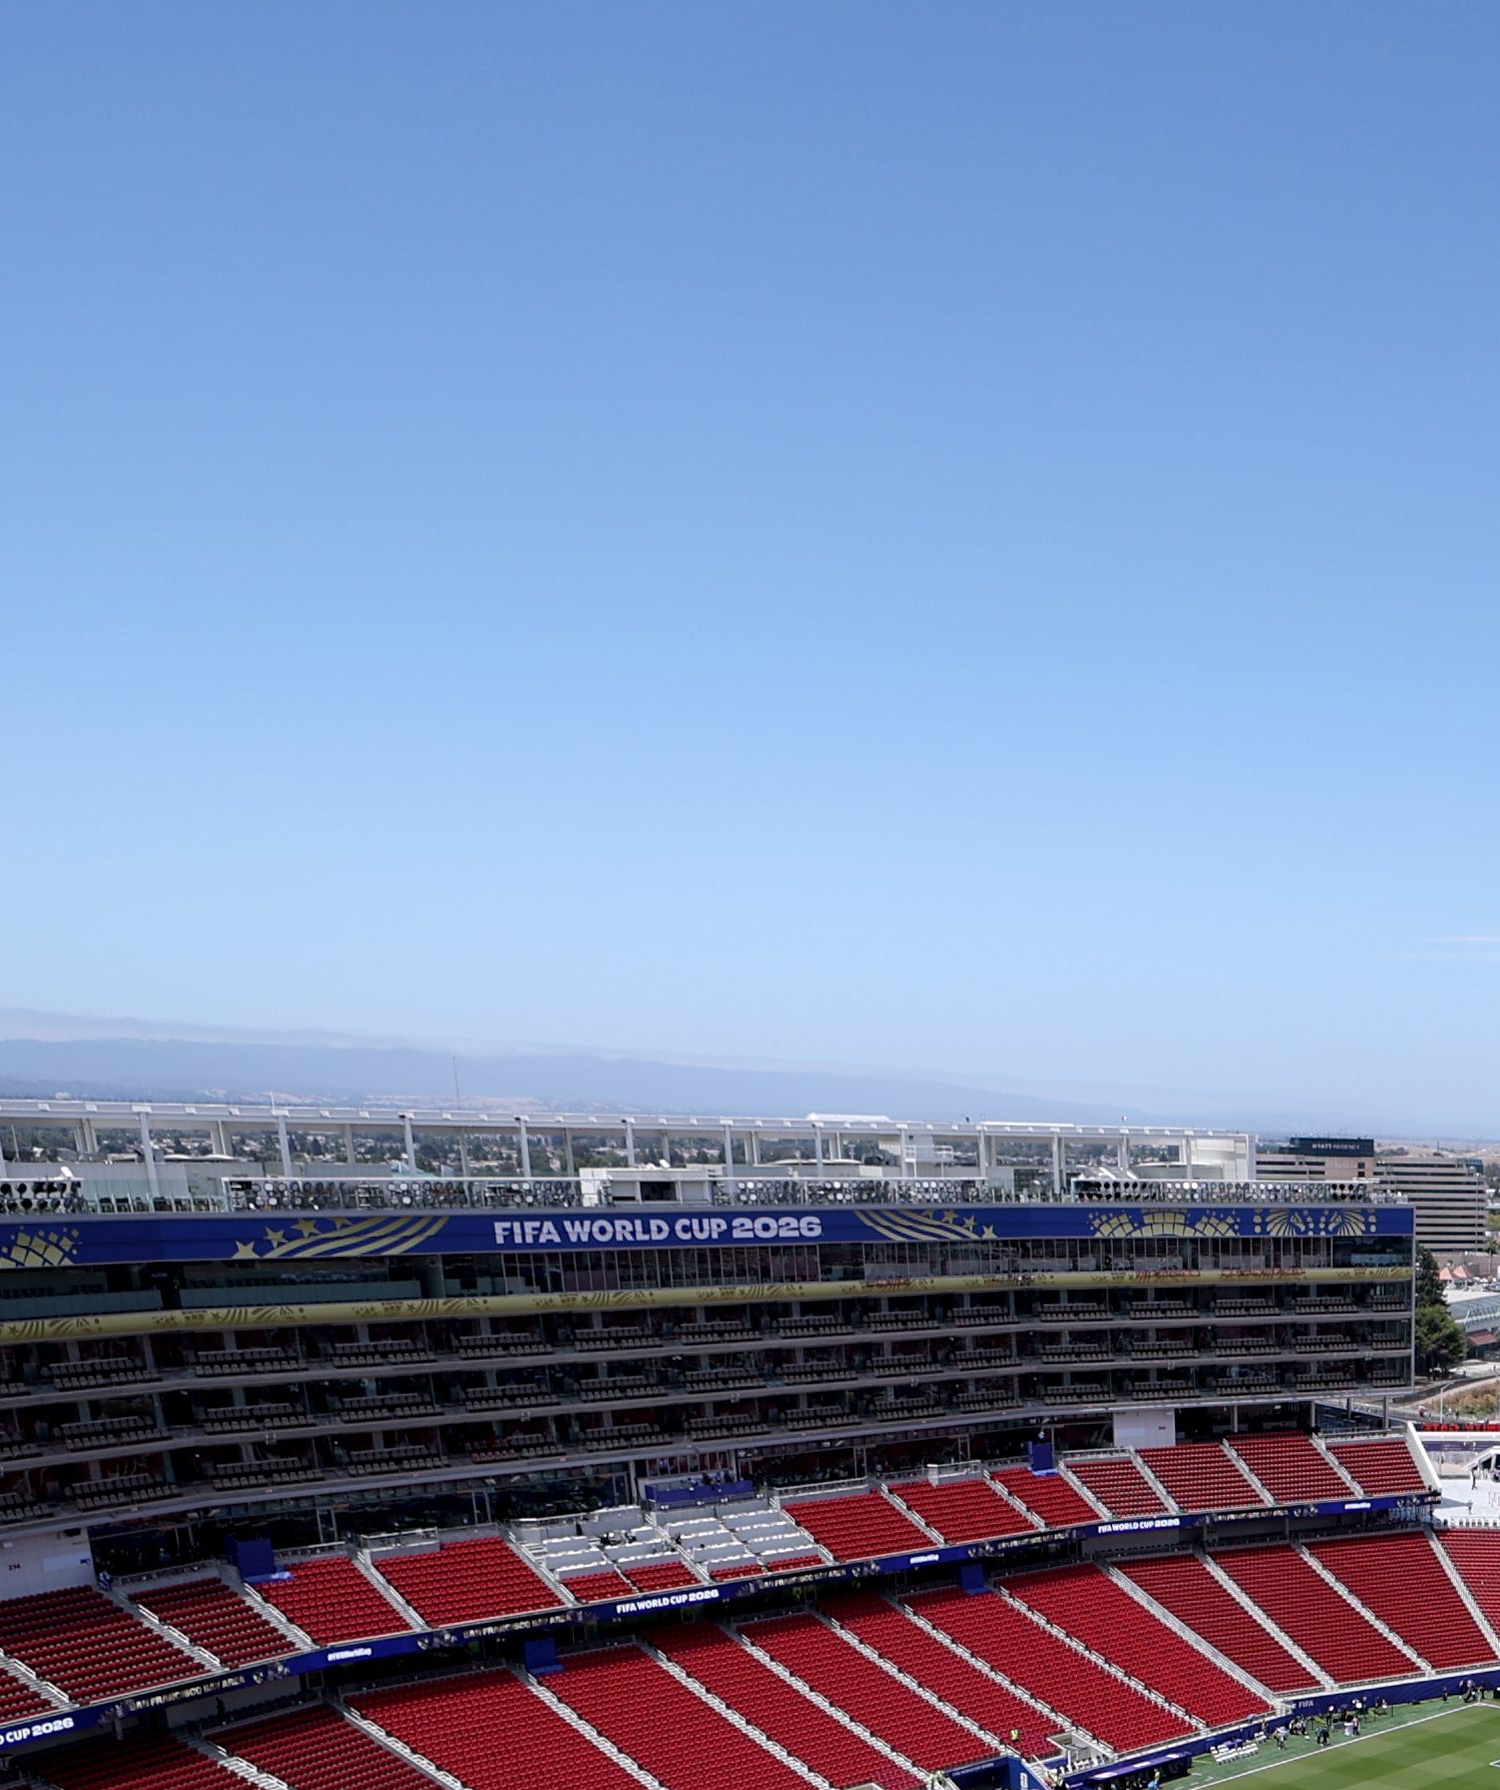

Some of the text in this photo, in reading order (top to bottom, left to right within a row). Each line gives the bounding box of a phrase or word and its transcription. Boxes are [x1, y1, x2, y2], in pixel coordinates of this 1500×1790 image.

[494, 1216, 822, 1245] FIFA WORLD CUP 2026
[1098, 1525, 1112, 1534] FIFA
[1112, 1522, 1139, 1531] WORLD
[1139, 1520, 1154, 1529] CUP
[616, 1589, 720, 1614] FIFA WORLD CUP 2026
[1298, 1700, 1314, 1708] FIFA
[6, 1726, 32, 1743] CUP
[32, 1718, 74, 1737] 2026
